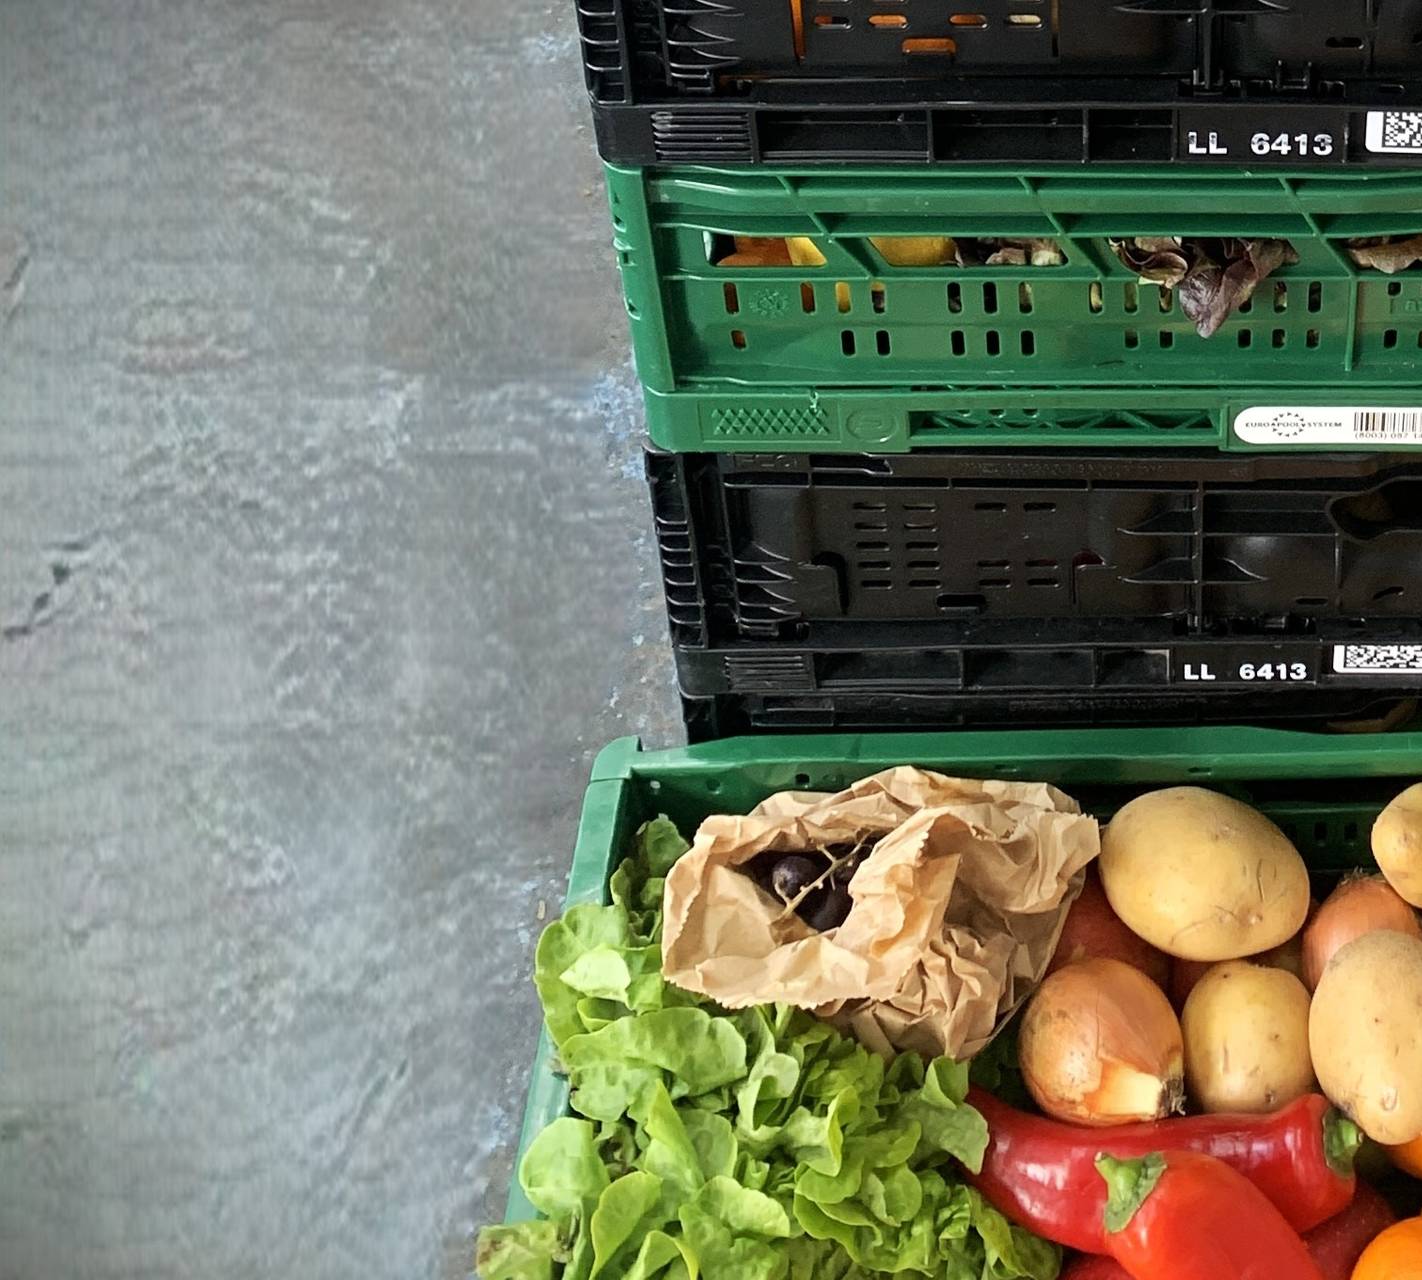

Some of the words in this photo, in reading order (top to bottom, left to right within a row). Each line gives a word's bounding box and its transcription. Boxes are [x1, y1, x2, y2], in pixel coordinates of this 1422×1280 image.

[1188, 131, 1228, 154] LL
[1250, 132, 1333, 156] 6413
[1183, 663, 1216, 680] LL
[1239, 663, 1307, 680] 6413
